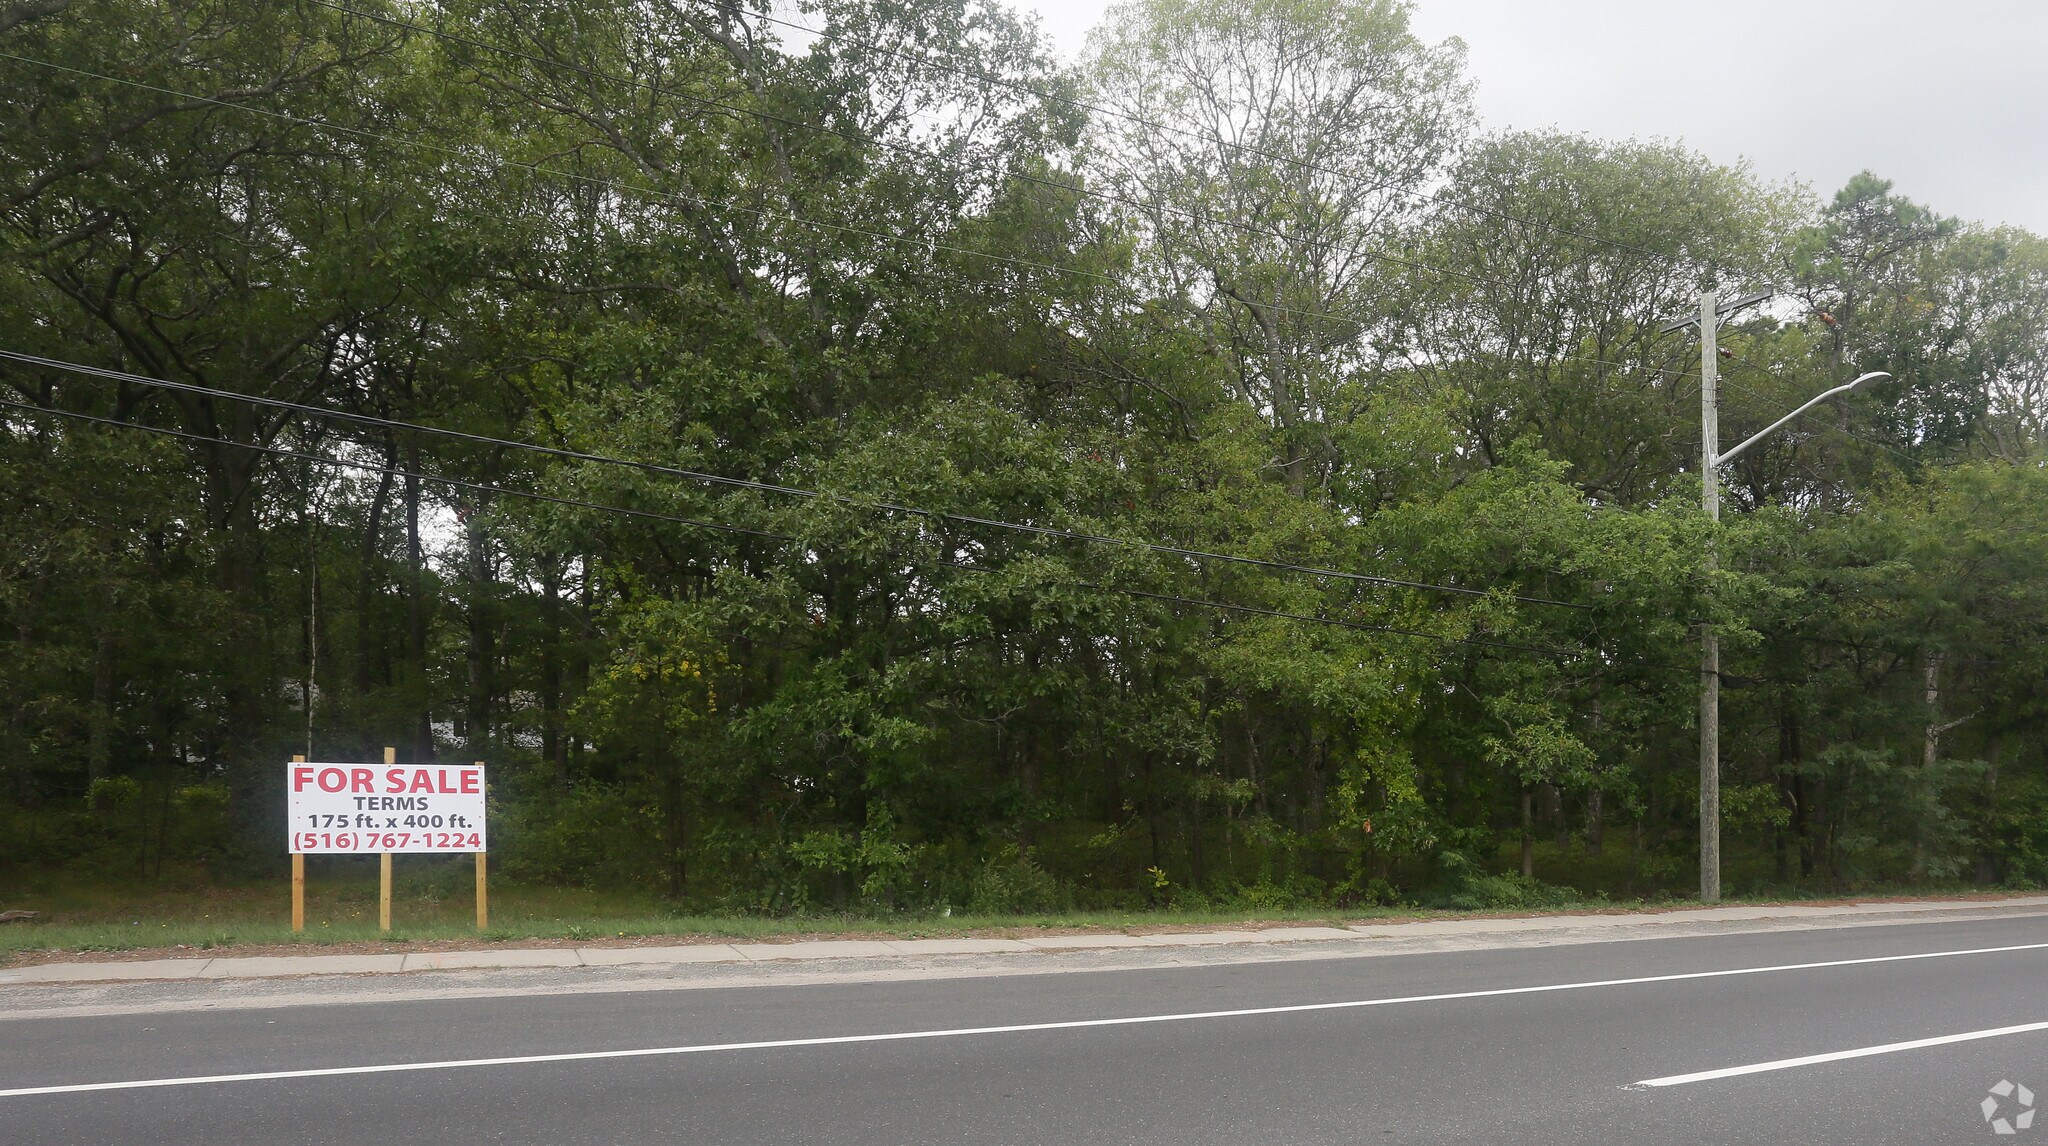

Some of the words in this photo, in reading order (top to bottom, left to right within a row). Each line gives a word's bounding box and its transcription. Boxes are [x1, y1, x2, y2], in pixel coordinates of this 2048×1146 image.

[294, 767, 375, 793] FOR
[386, 769, 480, 794] SALE
[353, 796, 429, 811] TERMS
[308, 814, 349, 828] 175
[355, 813, 380, 828] ft.
[385, 817, 398, 828] x
[403, 814, 443, 828] 400
[448, 813, 473, 828] ft.
[294, 832, 359, 851] (516)
[367, 832, 481, 849] 767-1224
